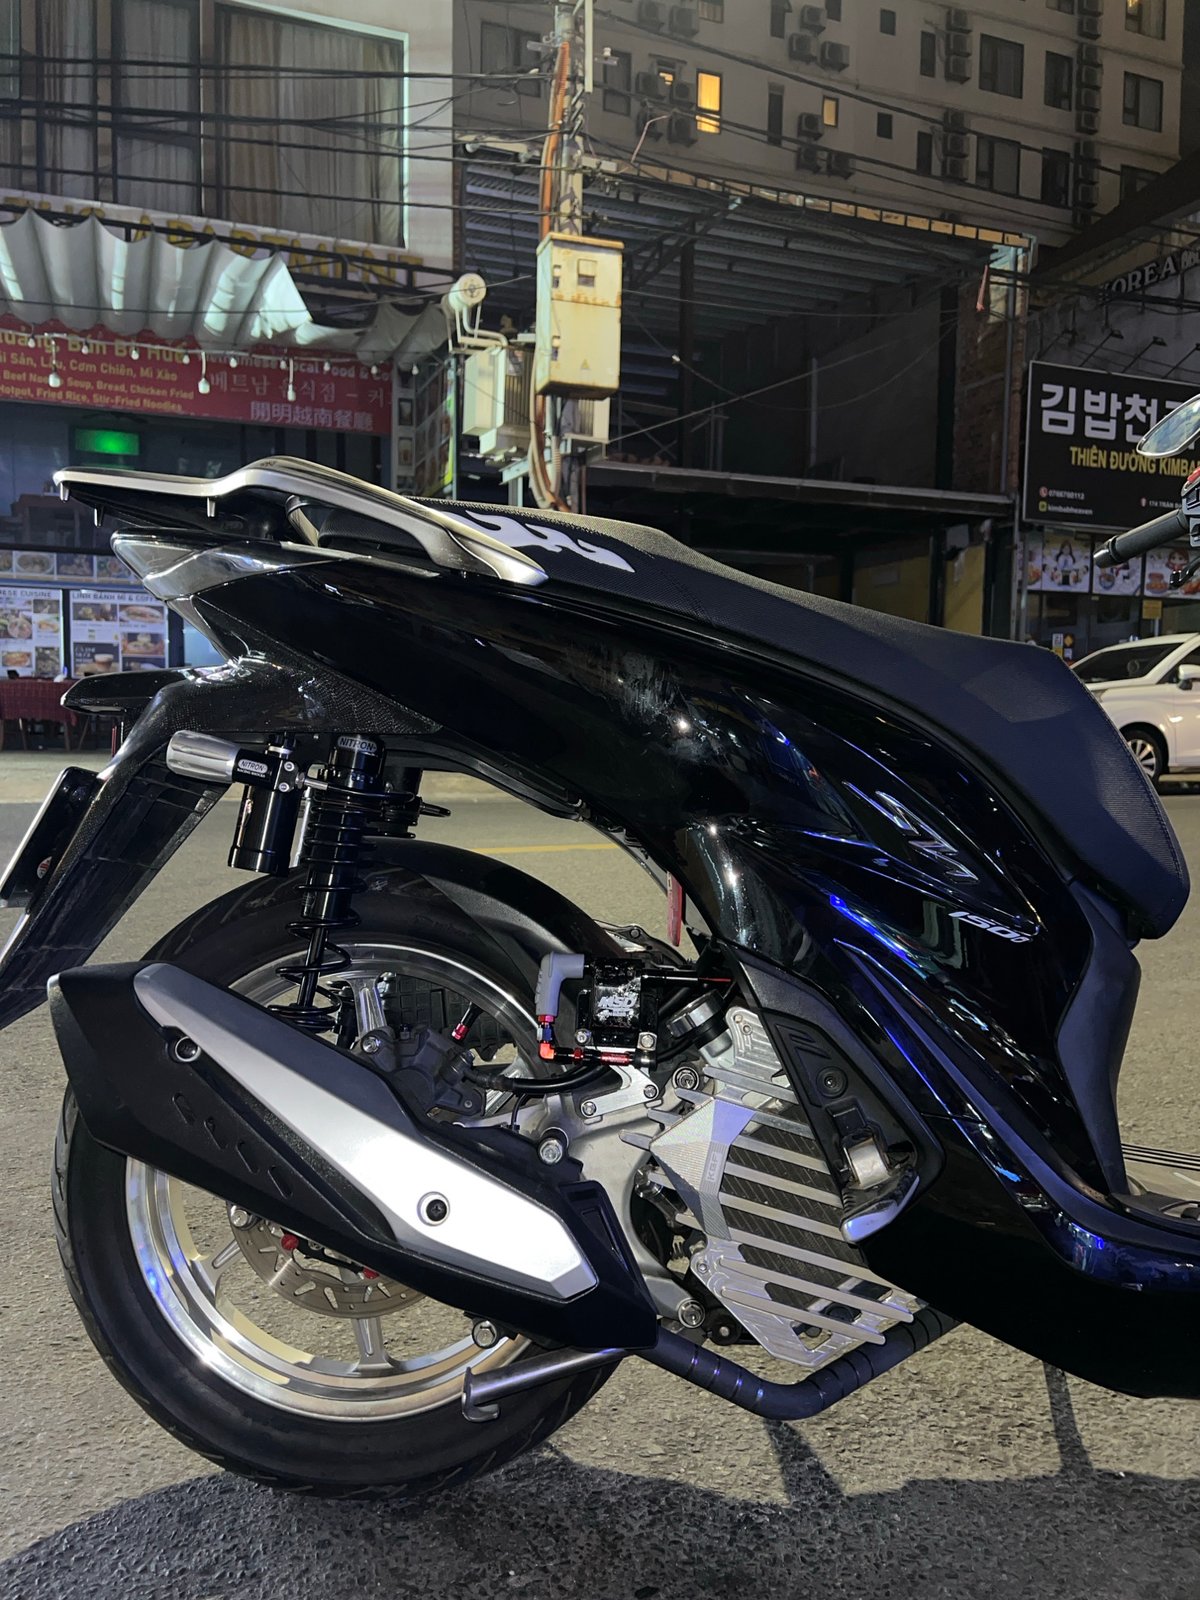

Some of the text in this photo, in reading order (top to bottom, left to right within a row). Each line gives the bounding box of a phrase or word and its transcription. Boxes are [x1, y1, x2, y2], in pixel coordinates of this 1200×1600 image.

[134, 214, 424, 289] APRTMENT
[1100, 255, 1177, 301] OREA
[322, 361, 356, 378] ood
[1070, 446, 1107, 470] THIÊN
[1159, 456, 1200, 478] KIMBA
[339, 737, 375, 751] NITRON
[240, 760, 266, 771] NITRON
